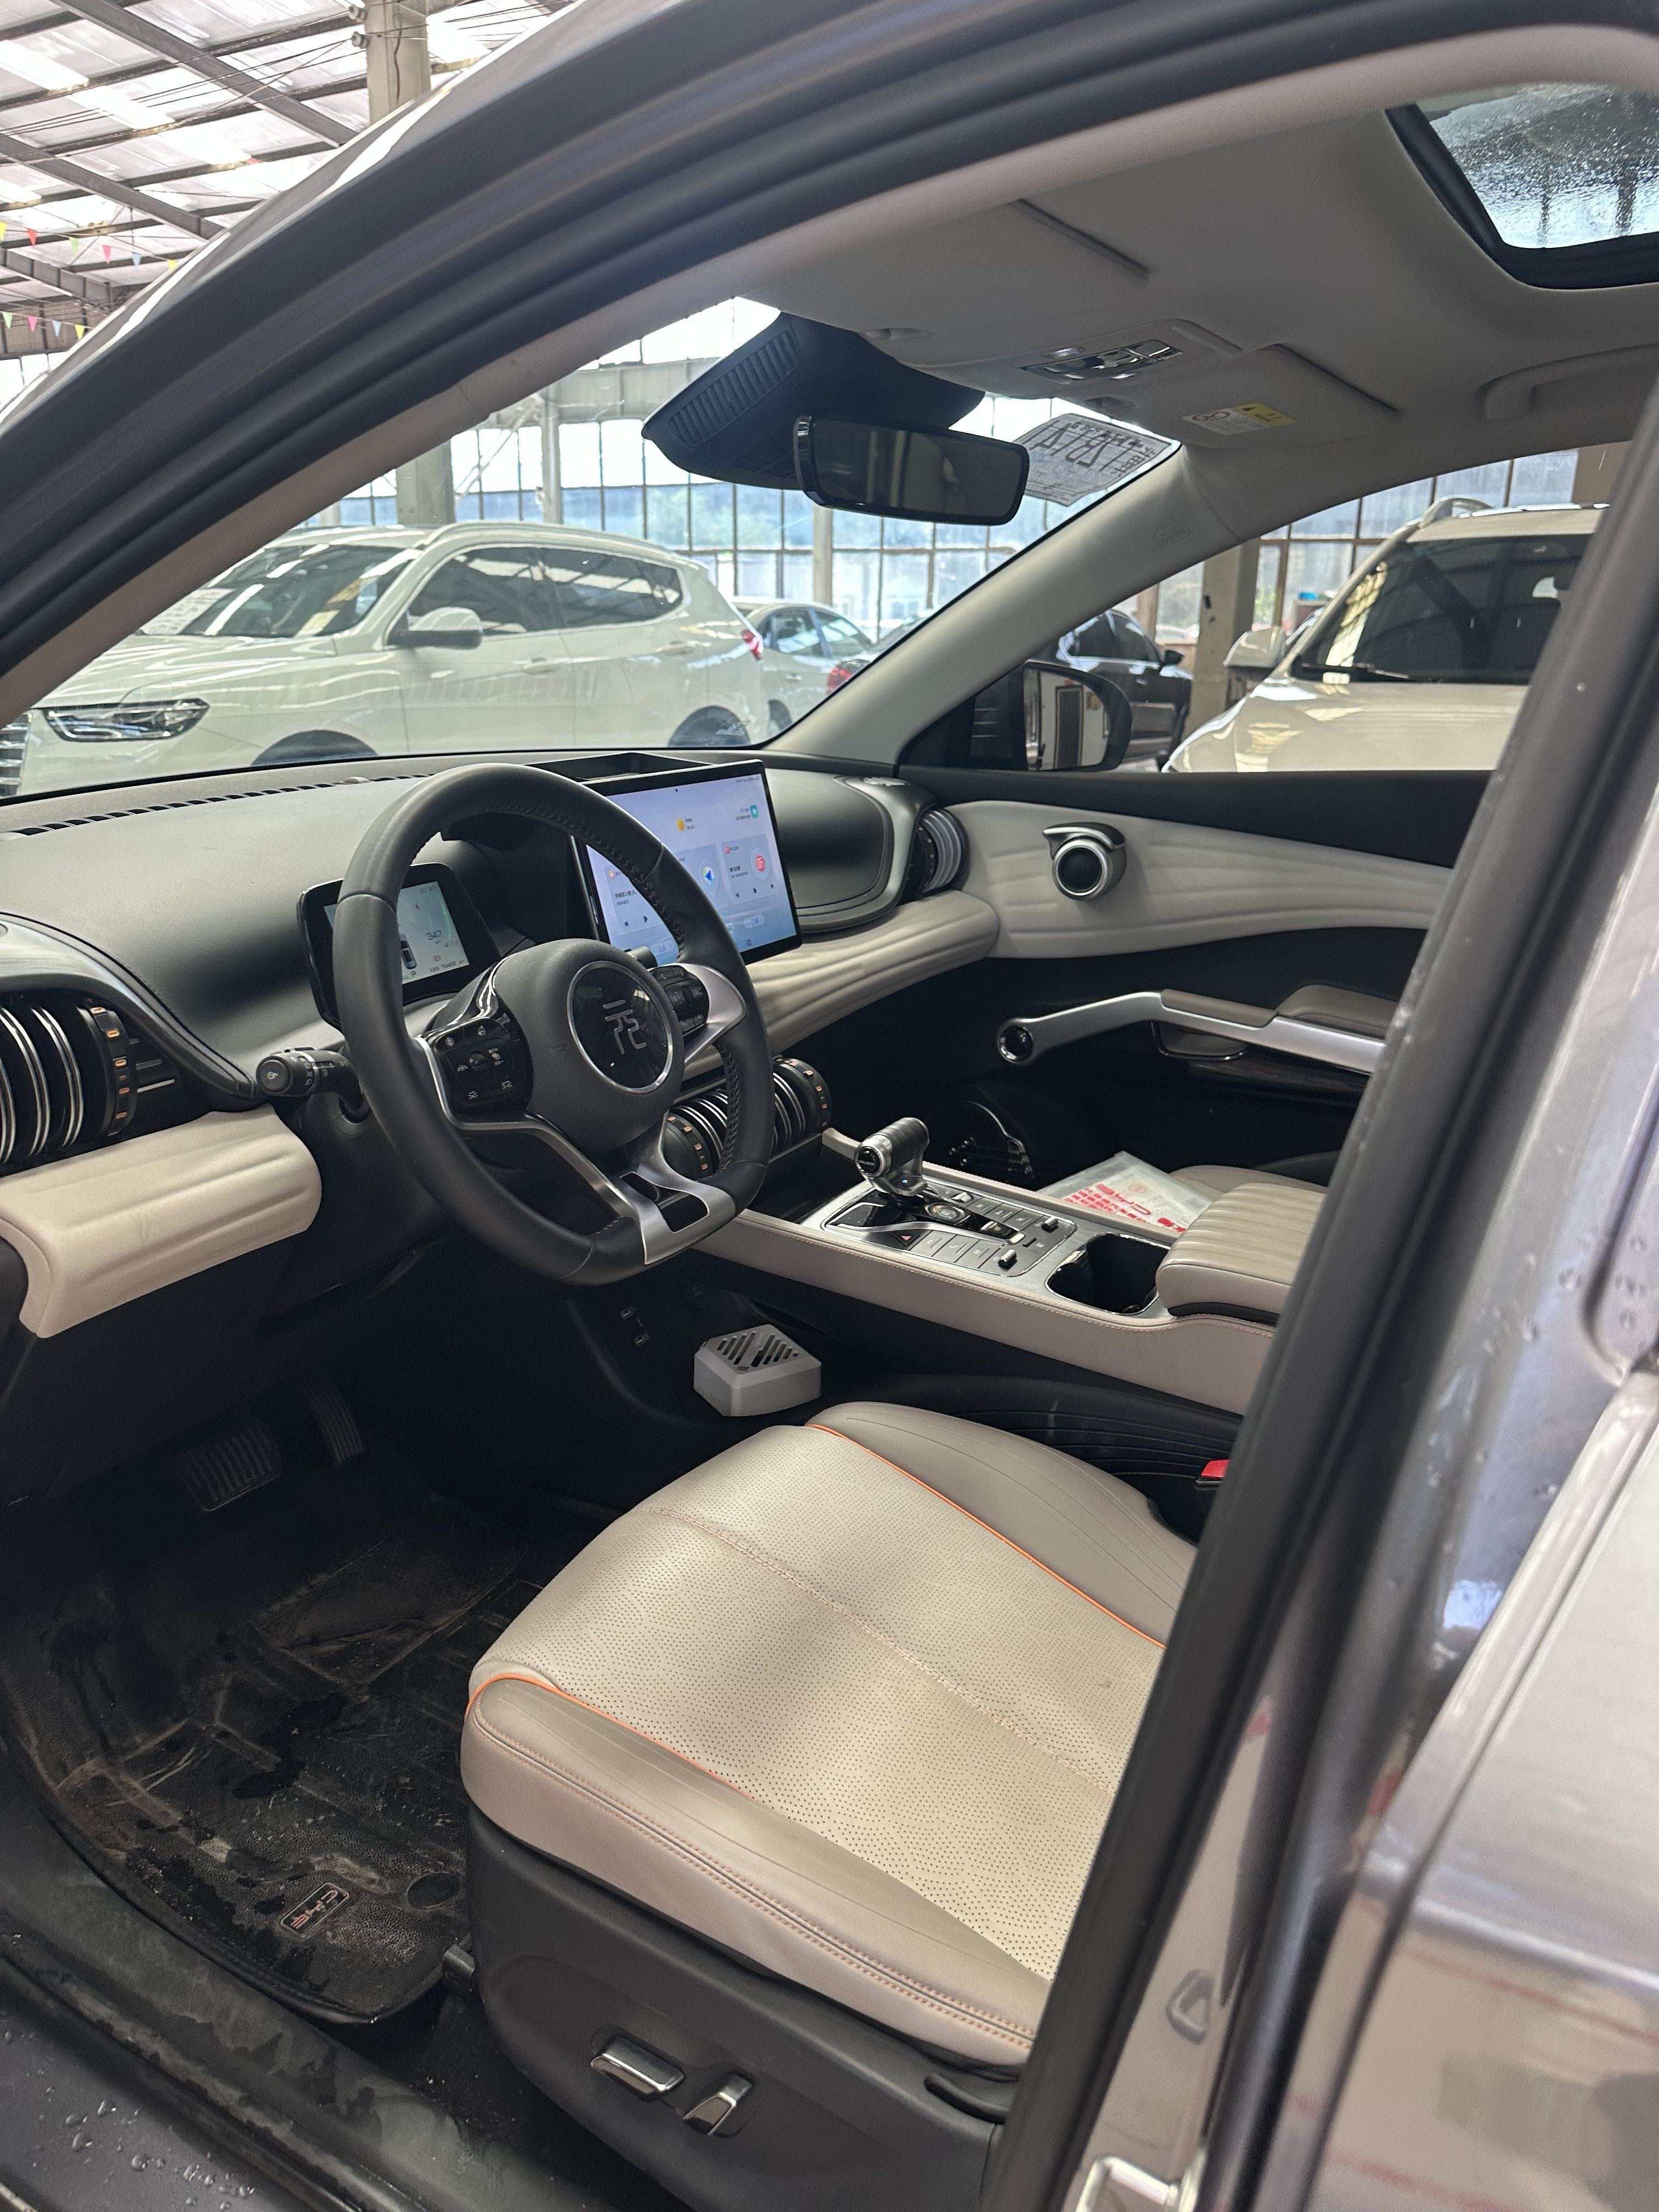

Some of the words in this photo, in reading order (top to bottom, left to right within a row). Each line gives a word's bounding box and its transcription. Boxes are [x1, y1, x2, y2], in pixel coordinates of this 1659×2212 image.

[426, 930, 442, 940] 347
[1095, 1183, 1151, 1215] BYD
[290, 1889, 338, 1929] BYD
